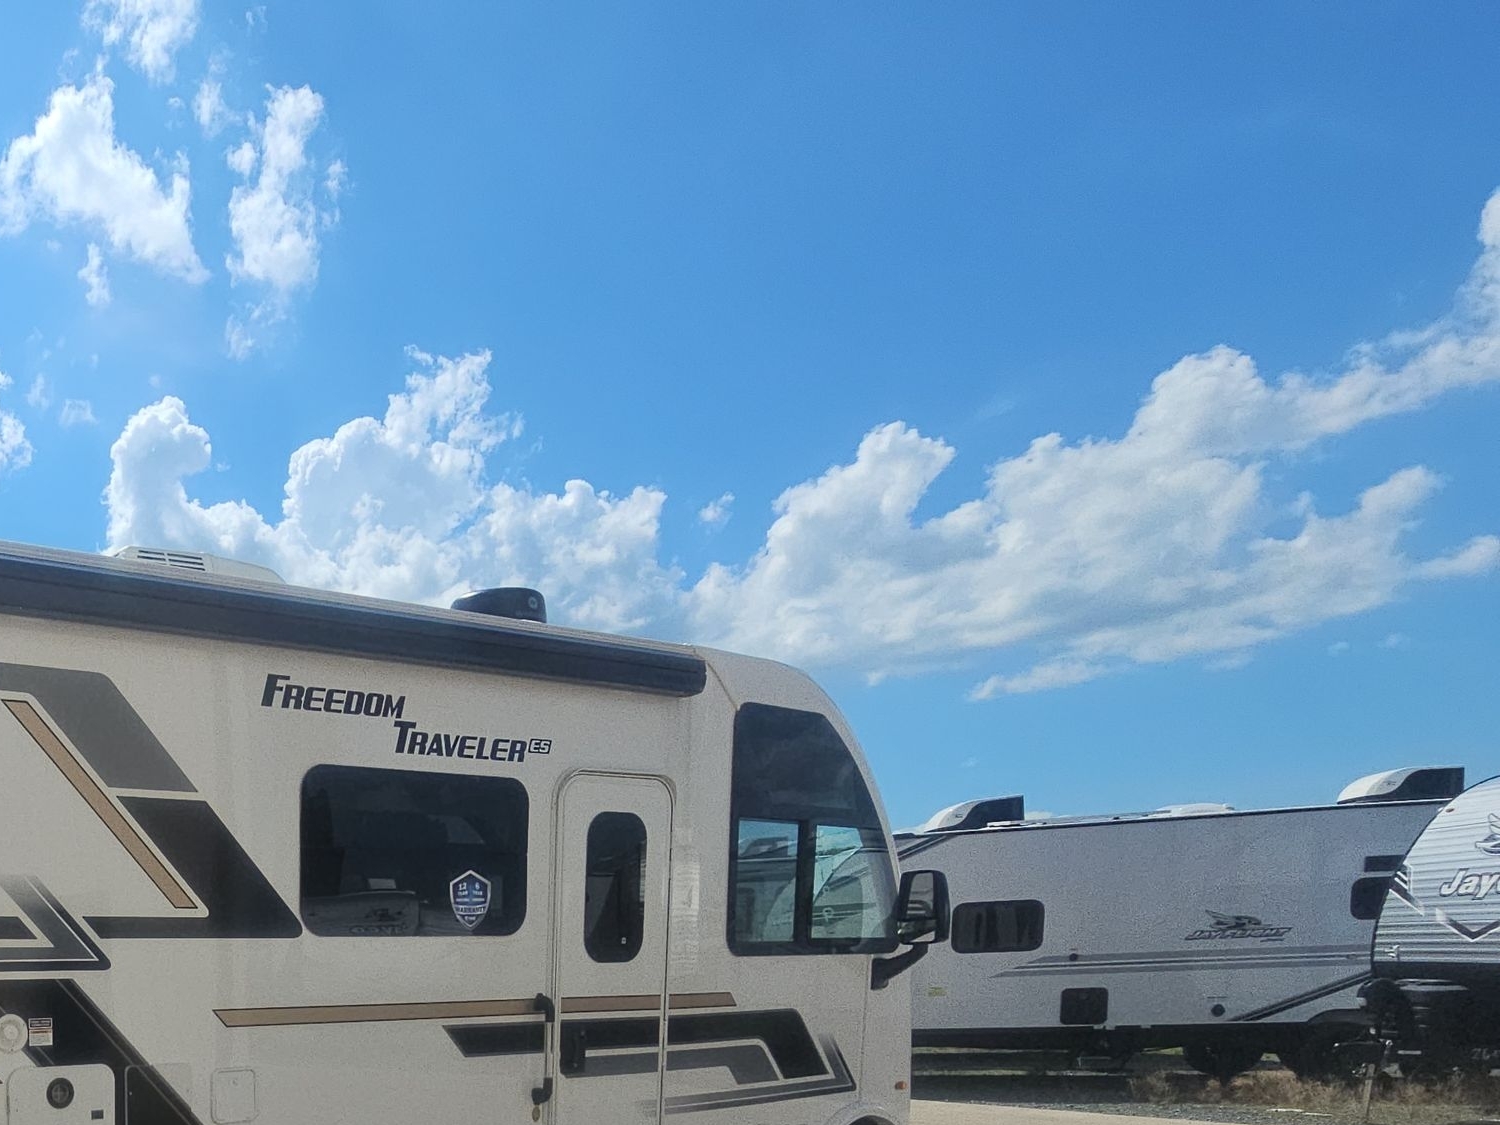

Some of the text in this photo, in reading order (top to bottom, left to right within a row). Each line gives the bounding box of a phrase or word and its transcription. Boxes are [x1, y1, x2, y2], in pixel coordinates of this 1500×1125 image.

[260, 673, 406, 719] FREEDOM
[393, 720, 552, 763] TRAVELER ES
[1439, 867, 1500, 900] Jay
